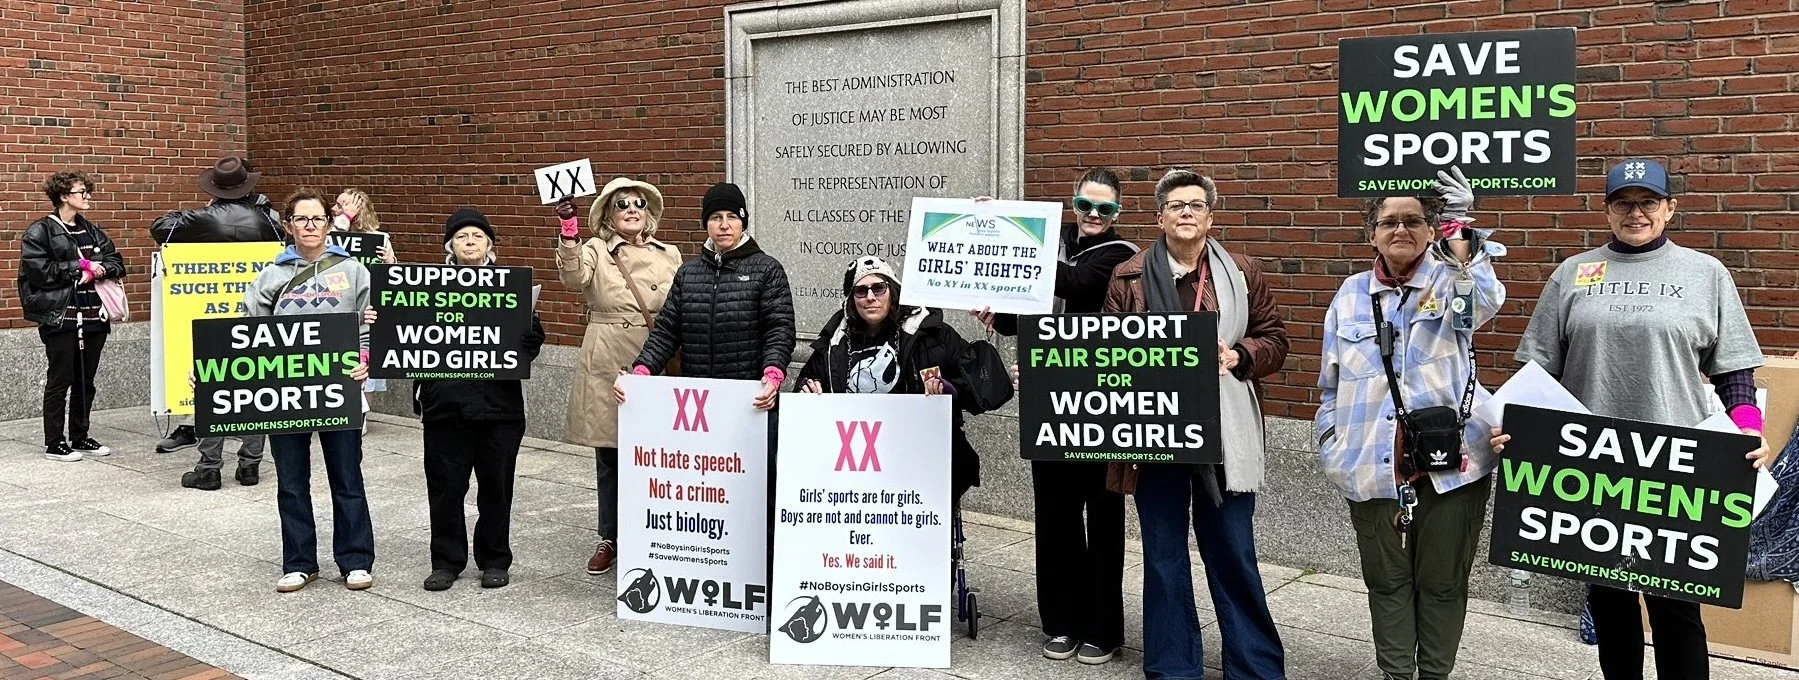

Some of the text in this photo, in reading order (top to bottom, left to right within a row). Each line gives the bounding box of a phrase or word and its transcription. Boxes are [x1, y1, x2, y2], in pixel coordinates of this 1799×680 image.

[1394, 40, 1520, 78] SAVE
[785, 70, 955, 94] THE BEST ADMINISTRATION
[1341, 84, 1576, 124] WOMEN'S
[792, 105, 948, 126] OF JUSTICE MAY BE MOST
[775, 140, 967, 158] SAFELY SECURED BY ALLOWING
[1363, 129, 1551, 167] SPORTS
[545, 166, 586, 200] XX
[792, 175, 948, 190] THE REPRESENTATION OF
[1358, 177, 1556, 190] SAVEWOMPORTS.COM
[784, 210, 804, 222] ALL
[808, 210, 856, 222] CLASSES
[858, 210, 876, 222] OF
[878, 210, 904, 222] THE
[325, 235, 362, 251] AVE
[800, 242, 906, 257] IN COURTS OF JUS
[927, 241, 1037, 258] WHAT ABOUT THE
[172, 262, 247, 274] THERE'S
[388, 266, 510, 287] SUPPORT
[919, 258, 1042, 280] GIRLS' RIGHTS?
[170, 282, 251, 294] SUCH TH
[927, 278, 1032, 294] No XY in XX sports!
[1585, 282, 1683, 298] TITLE IX
[205, 302, 229, 314] AS
[381, 291, 518, 308] FAIR SPORTS
[436, 312, 464, 323] FOR
[1038, 314, 1187, 340] SUPPORT
[231, 322, 321, 349] SAVE
[396, 325, 500, 344] WOMEN
[196, 351, 359, 382] WOMEN'S
[382, 350, 518, 369] AND GIRLS
[1031, 347, 1199, 367] FAIR SPORTS
[1098, 373, 1132, 387] FOR
[212, 384, 344, 415] SPORTS
[1050, 391, 1179, 415] WOMEN
[673, 388, 710, 432] XX
[210, 416, 348, 433] SAVEWOMENSSPORTS.COM
[1036, 423, 1204, 448] AND GIRLS
[834, 421, 882, 472] XX
[1559, 423, 1698, 474] SAVE
[634, 446, 746, 476] Not hate speech.
[1064, 452, 1173, 461] SAVEWOMENSSPORTS.COM
[649, 478, 729, 504] Not a crime.
[800, 489, 923, 507] Girls' sports are for girls.
[1502, 458, 1752, 528] WOMEN'S
[646, 509, 728, 540] Just biology.
[781, 509, 941, 528] Boys are not and cannot be girls.
[850, 530, 873, 545] Ever.
[1518, 506, 1720, 571] SPORTS
[650, 542, 730, 556] #NoBoysinGirlsSports
[648, 552, 728, 566] #SaveWomensSports
[822, 553, 897, 569] Yes. We said it.
[1511, 551, 1720, 598] SAVEWOMENSSPORTS.COM
[799, 581, 925, 594] #NoBoysinGirlsSports
[665, 606, 697, 615] WOMEN'S
[699, 609, 739, 619] LIBERATION
